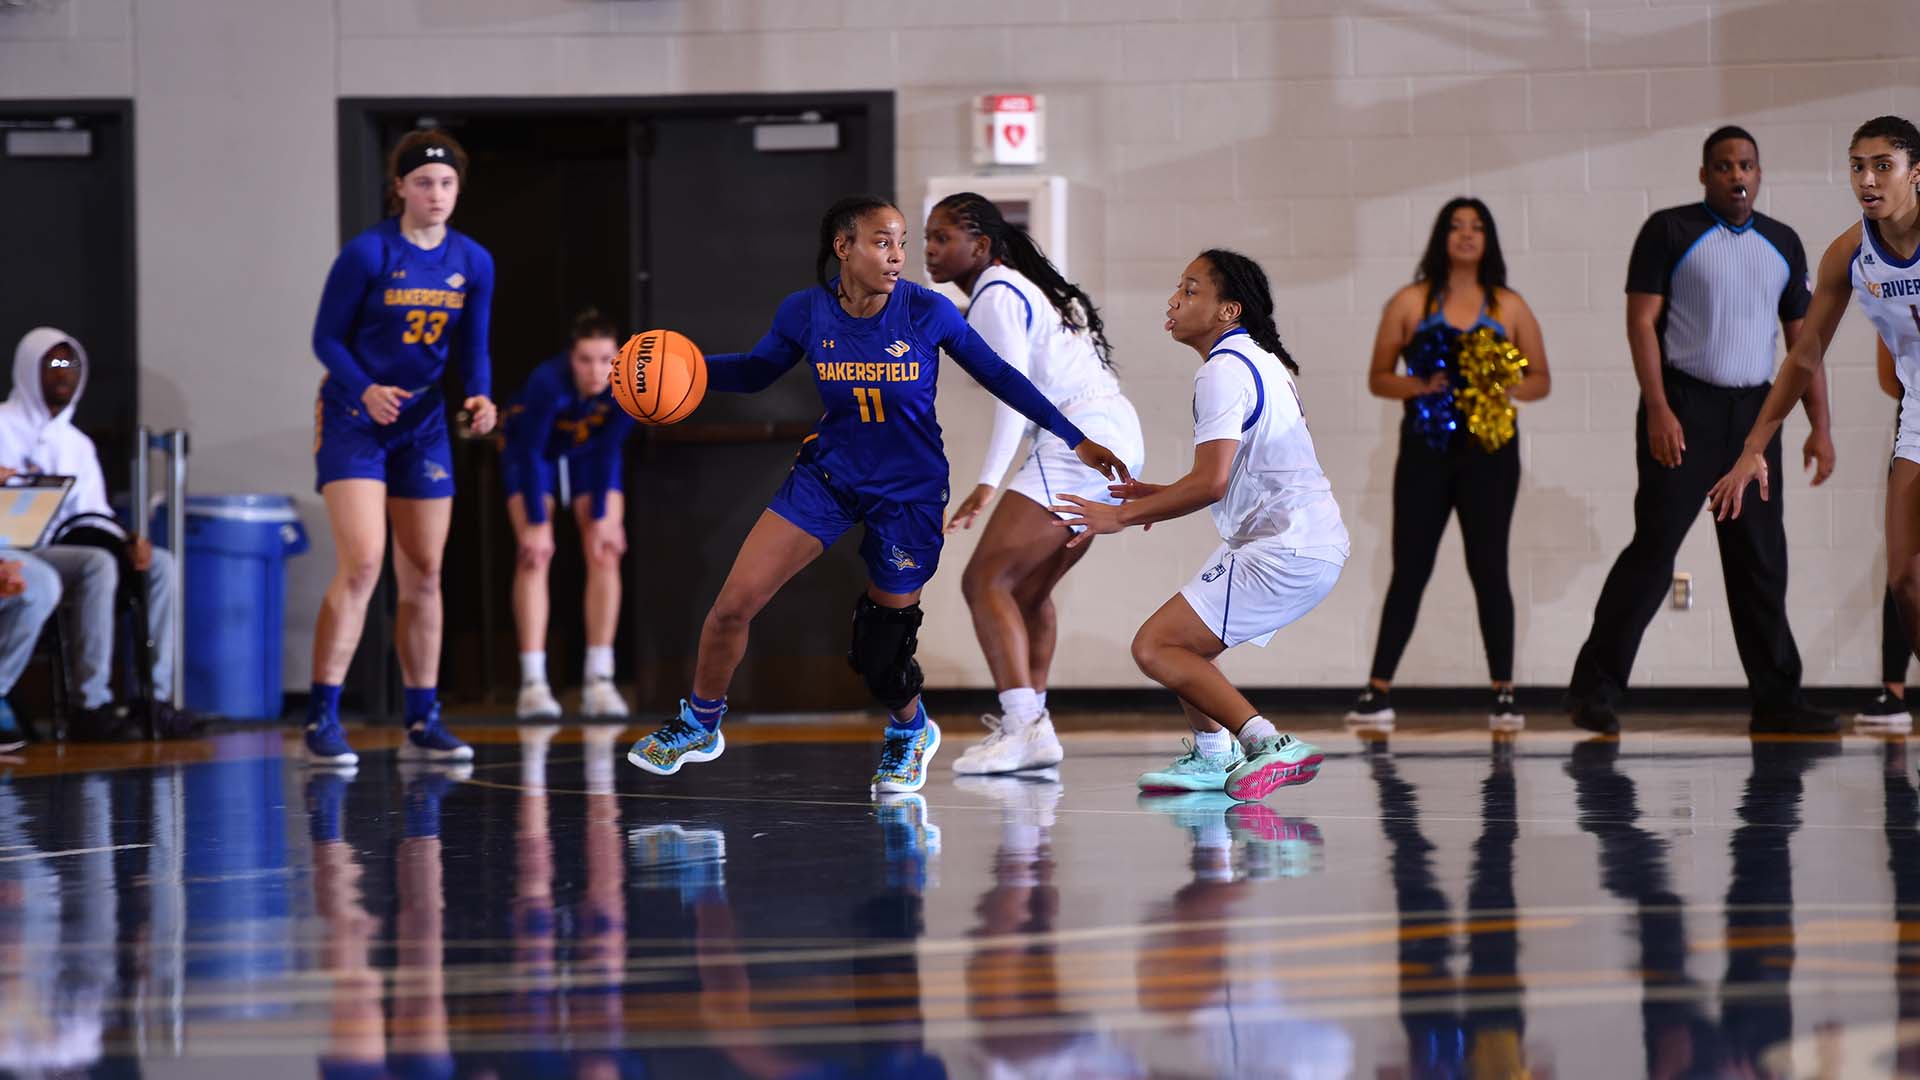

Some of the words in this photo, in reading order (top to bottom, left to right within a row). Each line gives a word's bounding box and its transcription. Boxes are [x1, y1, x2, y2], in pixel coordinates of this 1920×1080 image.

[402, 309, 449, 344] 33
[636, 336, 658, 394] Wilson
[816, 362, 920, 382] BAKERSFIELD
[853, 387, 885, 423] 11
